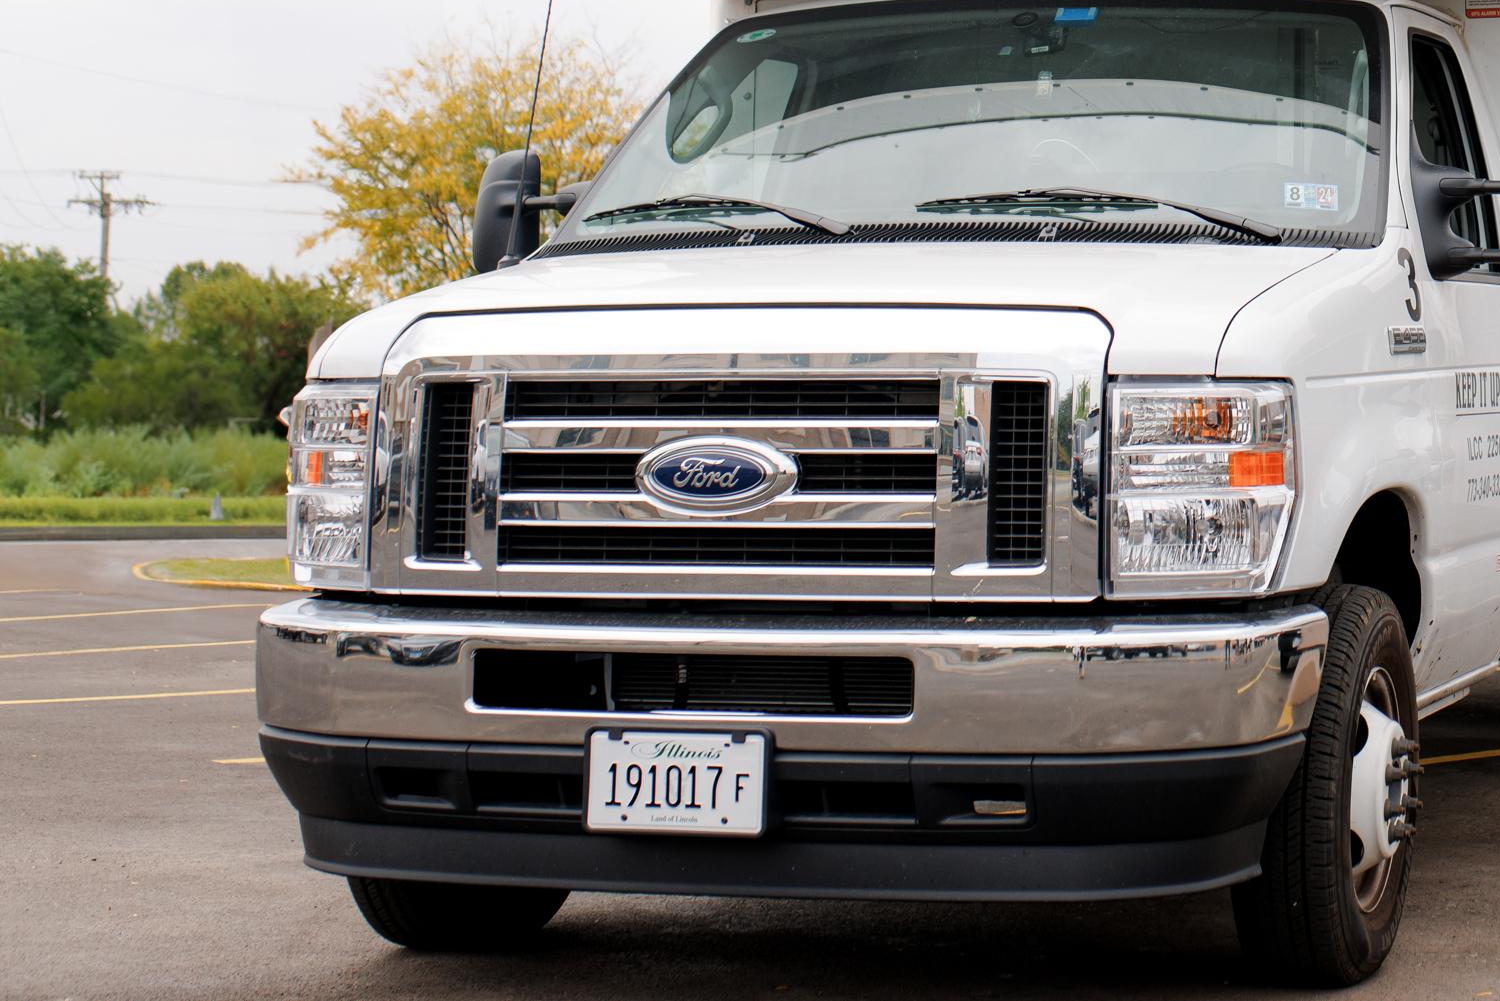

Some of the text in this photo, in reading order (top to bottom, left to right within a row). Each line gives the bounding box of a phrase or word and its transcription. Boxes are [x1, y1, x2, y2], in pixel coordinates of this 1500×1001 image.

[1290, 186, 1300, 201] 8
[1319, 188, 1332, 202] 24
[1398, 247, 1422, 322] 3
[1455, 371, 1477, 409] KEEP
[1479, 371, 1487, 408] IT
[1490, 371, 1500, 408] UP
[672, 457, 742, 489] Ford
[631, 740, 723, 760] Illinois
[605, 762, 750, 810] 191017 F
[651, 815, 698, 824] Land of Lincoln
